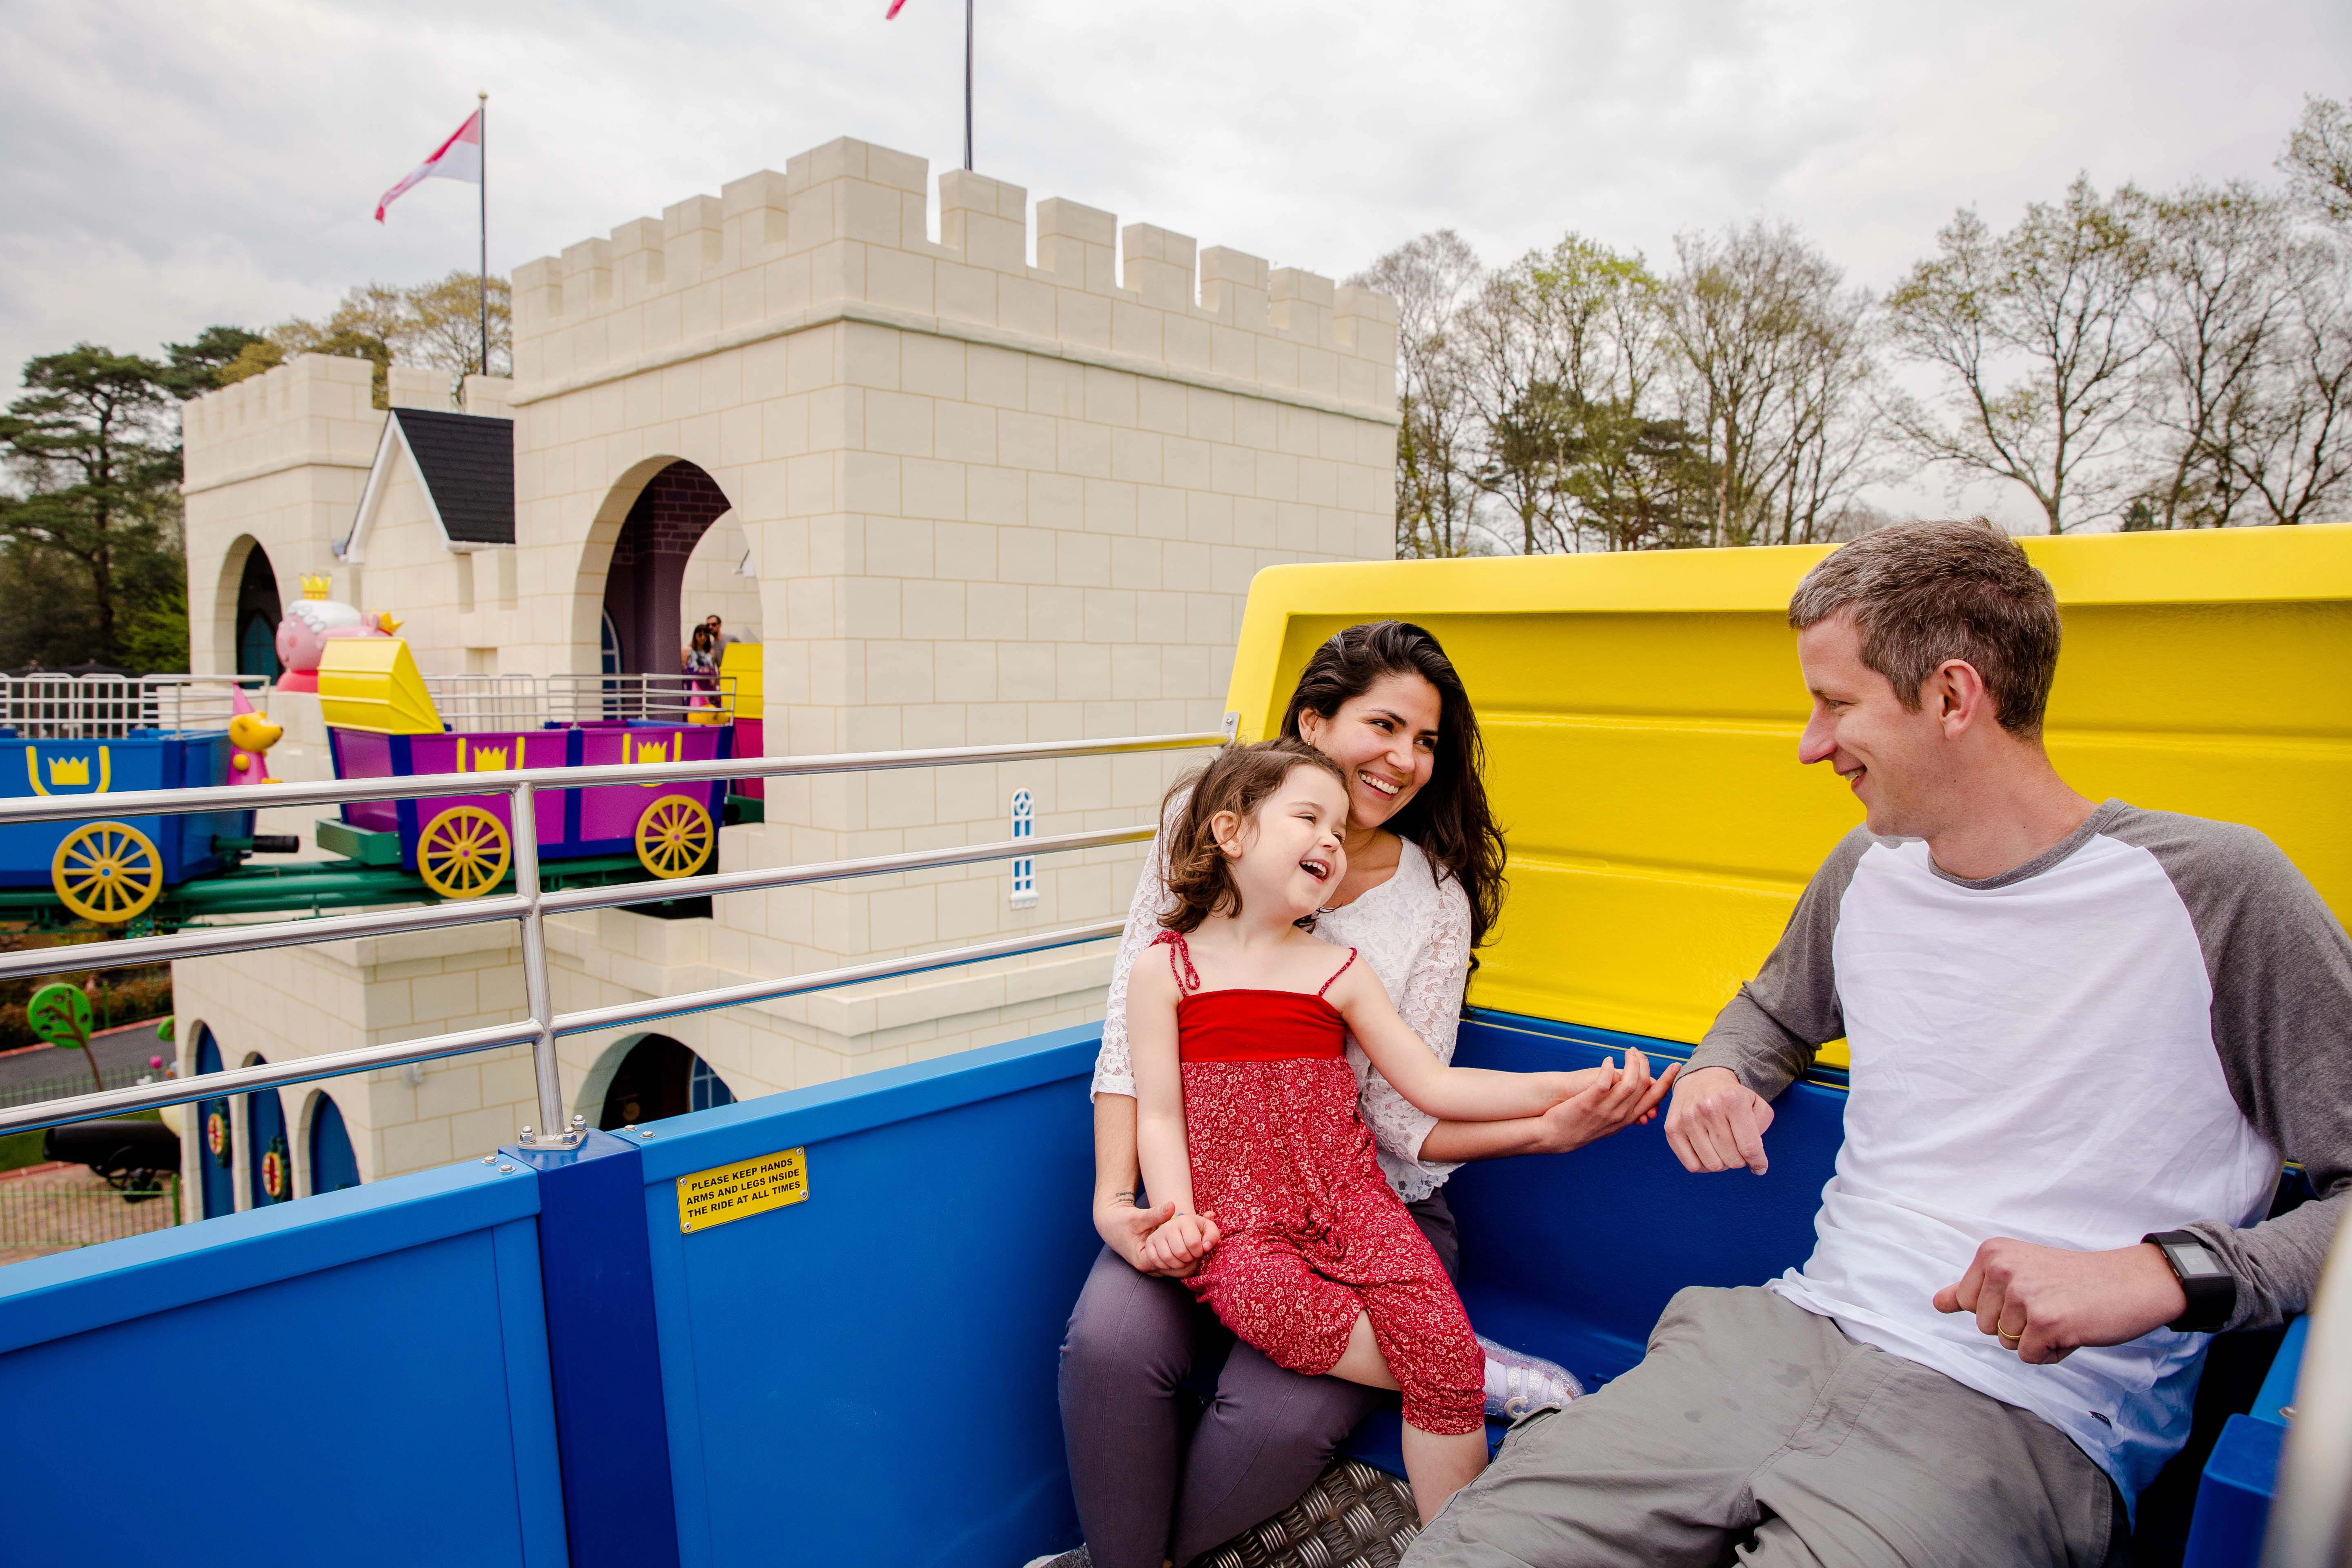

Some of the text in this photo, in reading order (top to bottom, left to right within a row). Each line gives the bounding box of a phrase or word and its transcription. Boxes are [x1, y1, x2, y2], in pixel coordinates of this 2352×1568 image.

[686, 1169, 800, 1206] ARMS AND LEGS INSIDE
[691, 1158, 793, 1191] PLEASE KEEP HANDS
[687, 1181, 800, 1218] THE RIDE AT ALL TIMES
